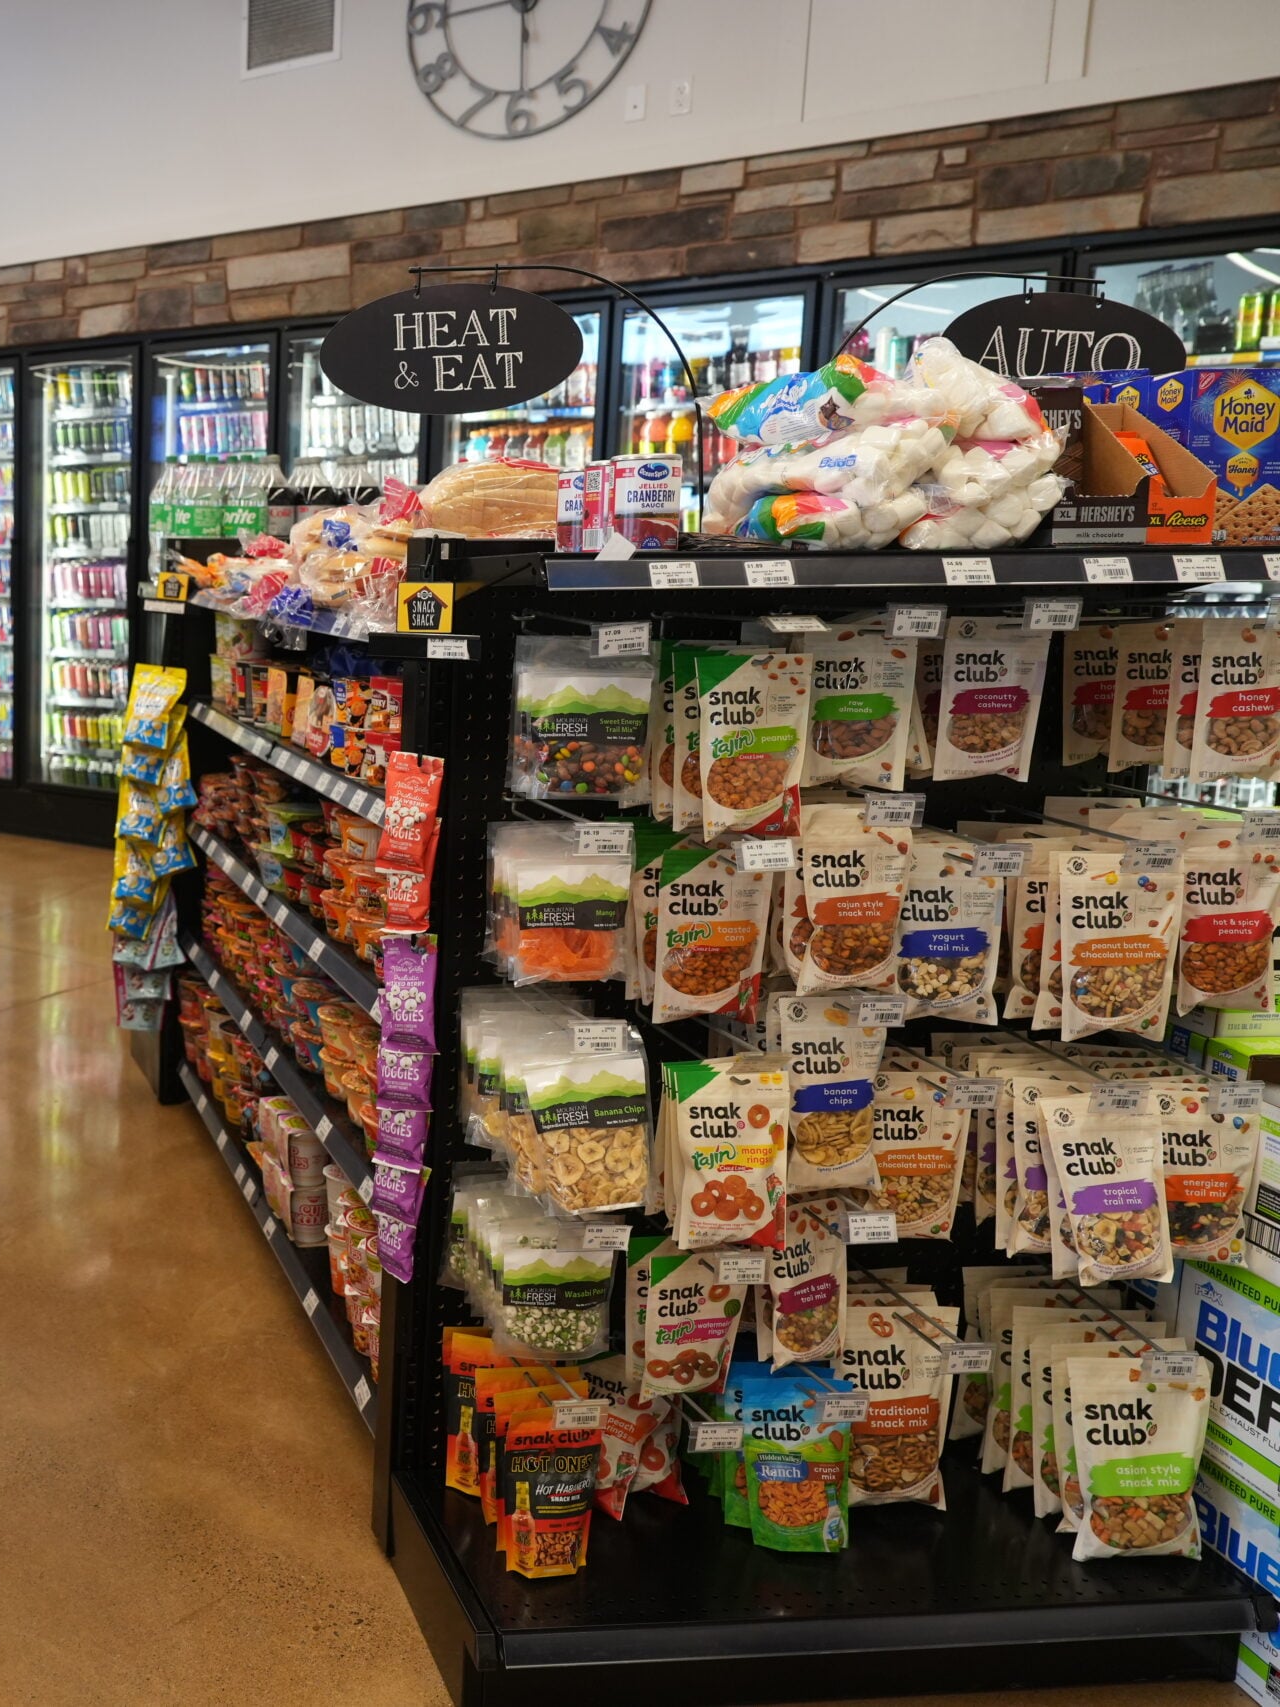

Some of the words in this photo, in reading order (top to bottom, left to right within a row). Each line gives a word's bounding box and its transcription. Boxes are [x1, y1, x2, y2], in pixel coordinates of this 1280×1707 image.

[506, 91, 533, 135] 6
[393, 308, 517, 351] HEAT
[977, 326, 1142, 377] AUTO
[394, 362, 419, 389] &
[434, 352, 522, 391] EAT
[1220, 396, 1274, 420] Honey
[1223, 412, 1265, 433] Maid
[627, 490, 675, 502] CRANBERRY
[1059, 509, 1071, 519] XL
[1080, 505, 1135, 523] HERSHEY'S
[1150, 516, 1161, 525] XL
[1167, 512, 1207, 527] Reese's
[412, 600, 435, 614] SNACK
[412, 614, 435, 627] SHACK
[814, 658, 864, 673] snak
[954, 650, 1005, 666] snak
[1211, 653, 1262, 669] snak
[815, 673, 860, 690] club
[954, 666, 999, 683] club
[1211, 668, 1258, 685] club
[709, 687, 760, 705] snak
[974, 693, 1017, 702] coconutty
[1239, 693, 1270, 703] honey
[839, 706, 872, 714] almonds
[977, 701, 1012, 709] cashews
[1232, 703, 1274, 712] cashews
[711, 706, 758, 726] club
[556, 723, 587, 732] FRESH
[811, 851, 865, 868] snak
[812, 870, 860, 887] club
[1186, 868, 1242, 886] snak
[669, 880, 724, 898] snak
[1071, 894, 1128, 910] snak
[1186, 888, 1235, 906] club
[669, 899, 718, 916] club
[544, 913, 575, 922] FRESH
[596, 909, 616, 918] Mango
[1072, 911, 1122, 929] club
[717, 926, 750, 934] toasted
[1218, 927, 1252, 936] peanuts
[932, 933, 964, 943] yogurt
[928, 943, 947, 952] trail
[951, 944, 970, 952] mix
[1092, 942, 1119, 951] peanut
[1123, 942, 1150, 950] butter
[1081, 951, 1121, 959] chocolate
[1125, 951, 1143, 959] trail
[1146, 951, 1161, 959] mix
[1212, 1061, 1237, 1081] Blue
[823, 1088, 858, 1096] banana
[829, 1097, 853, 1106] chips
[557, 1110, 589, 1122] FRESH
[594, 1107, 623, 1118] Banana
[625, 1104, 645, 1116] Chips
[689, 1103, 741, 1120] snak
[690, 1120, 737, 1138] club
[1104, 1187, 1137, 1197] tropical
[1183, 1180, 1228, 1190] energizer
[1104, 1197, 1123, 1205] trail
[1126, 1197, 1143, 1205] mix
[1197, 1260, 1260, 1301] GUARANTEED
[565, 1289, 590, 1298] Wasabi
[869, 1405, 929, 1416] traditional
[871, 1418, 900, 1428] snack
[904, 1418, 928, 1427] mix
[1220, 1407, 1260, 1440] EXHAUST
[512, 1456, 550, 1472] HOT
[555, 1454, 592, 1473] ONES
[1116, 1465, 1146, 1475] asian
[1150, 1464, 1181, 1476] style
[761, 1465, 802, 1478] Ranch
[821, 1472, 835, 1480] mix
[1119, 1477, 1150, 1488] snack
[1153, 1477, 1181, 1487] mix
[1249, 1494, 1276, 1521] PURE
[1252, 1631, 1278, 1658] FLUID
